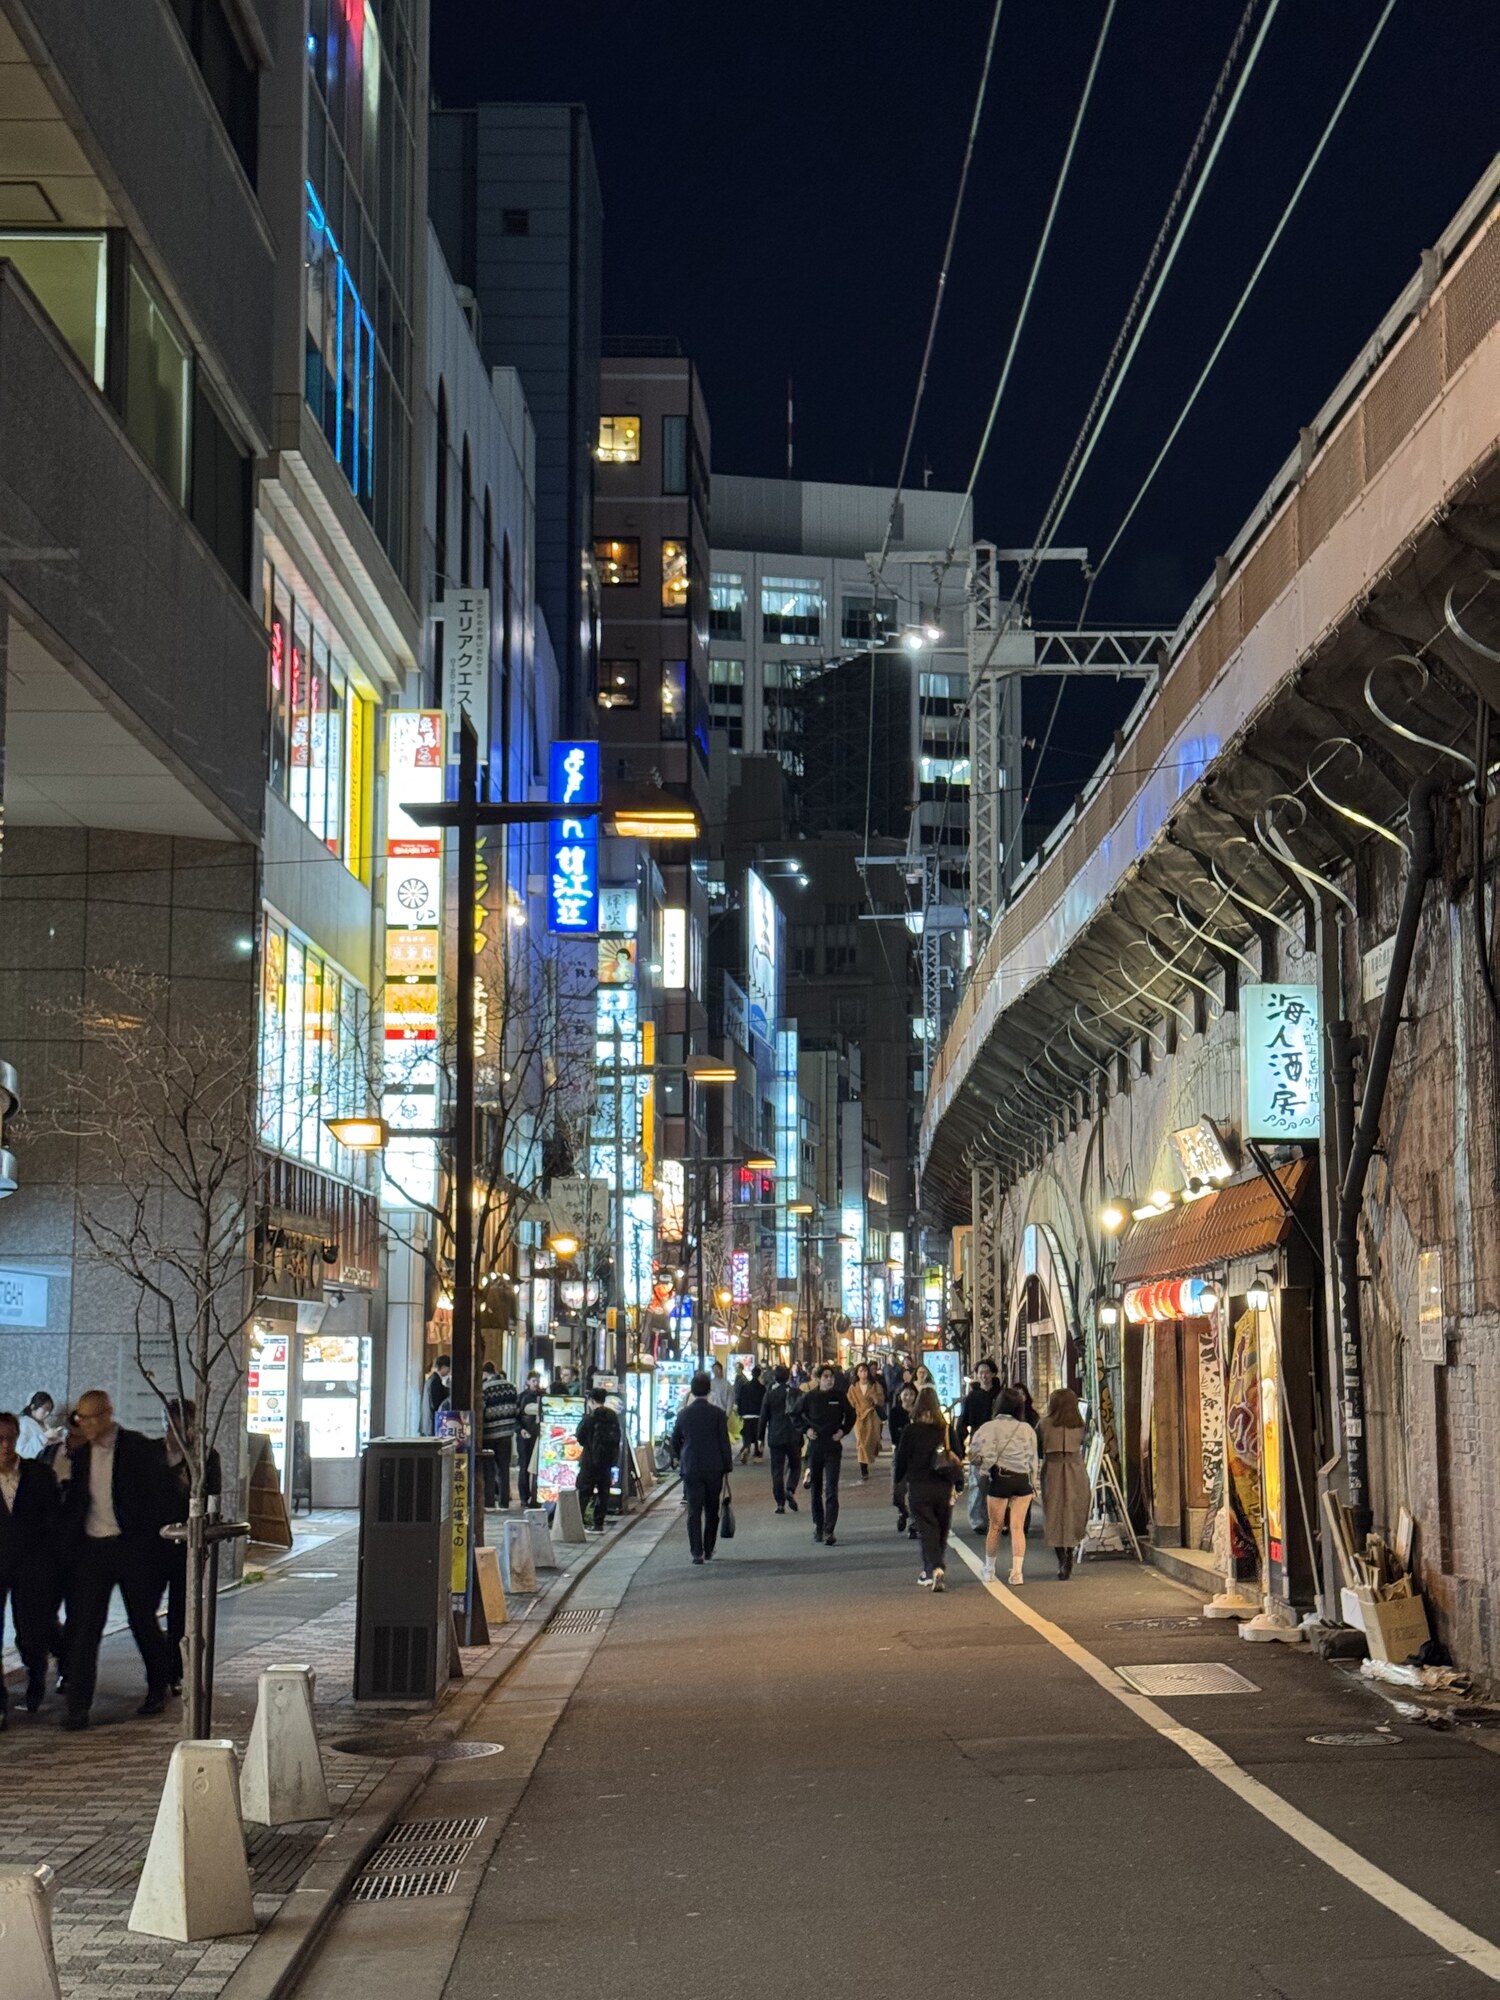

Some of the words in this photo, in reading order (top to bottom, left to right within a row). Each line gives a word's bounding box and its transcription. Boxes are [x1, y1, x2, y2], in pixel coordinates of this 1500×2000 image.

[457, 599, 474, 720] エリアクエス
[1264, 993, 1312, 1117] 海人酒房
